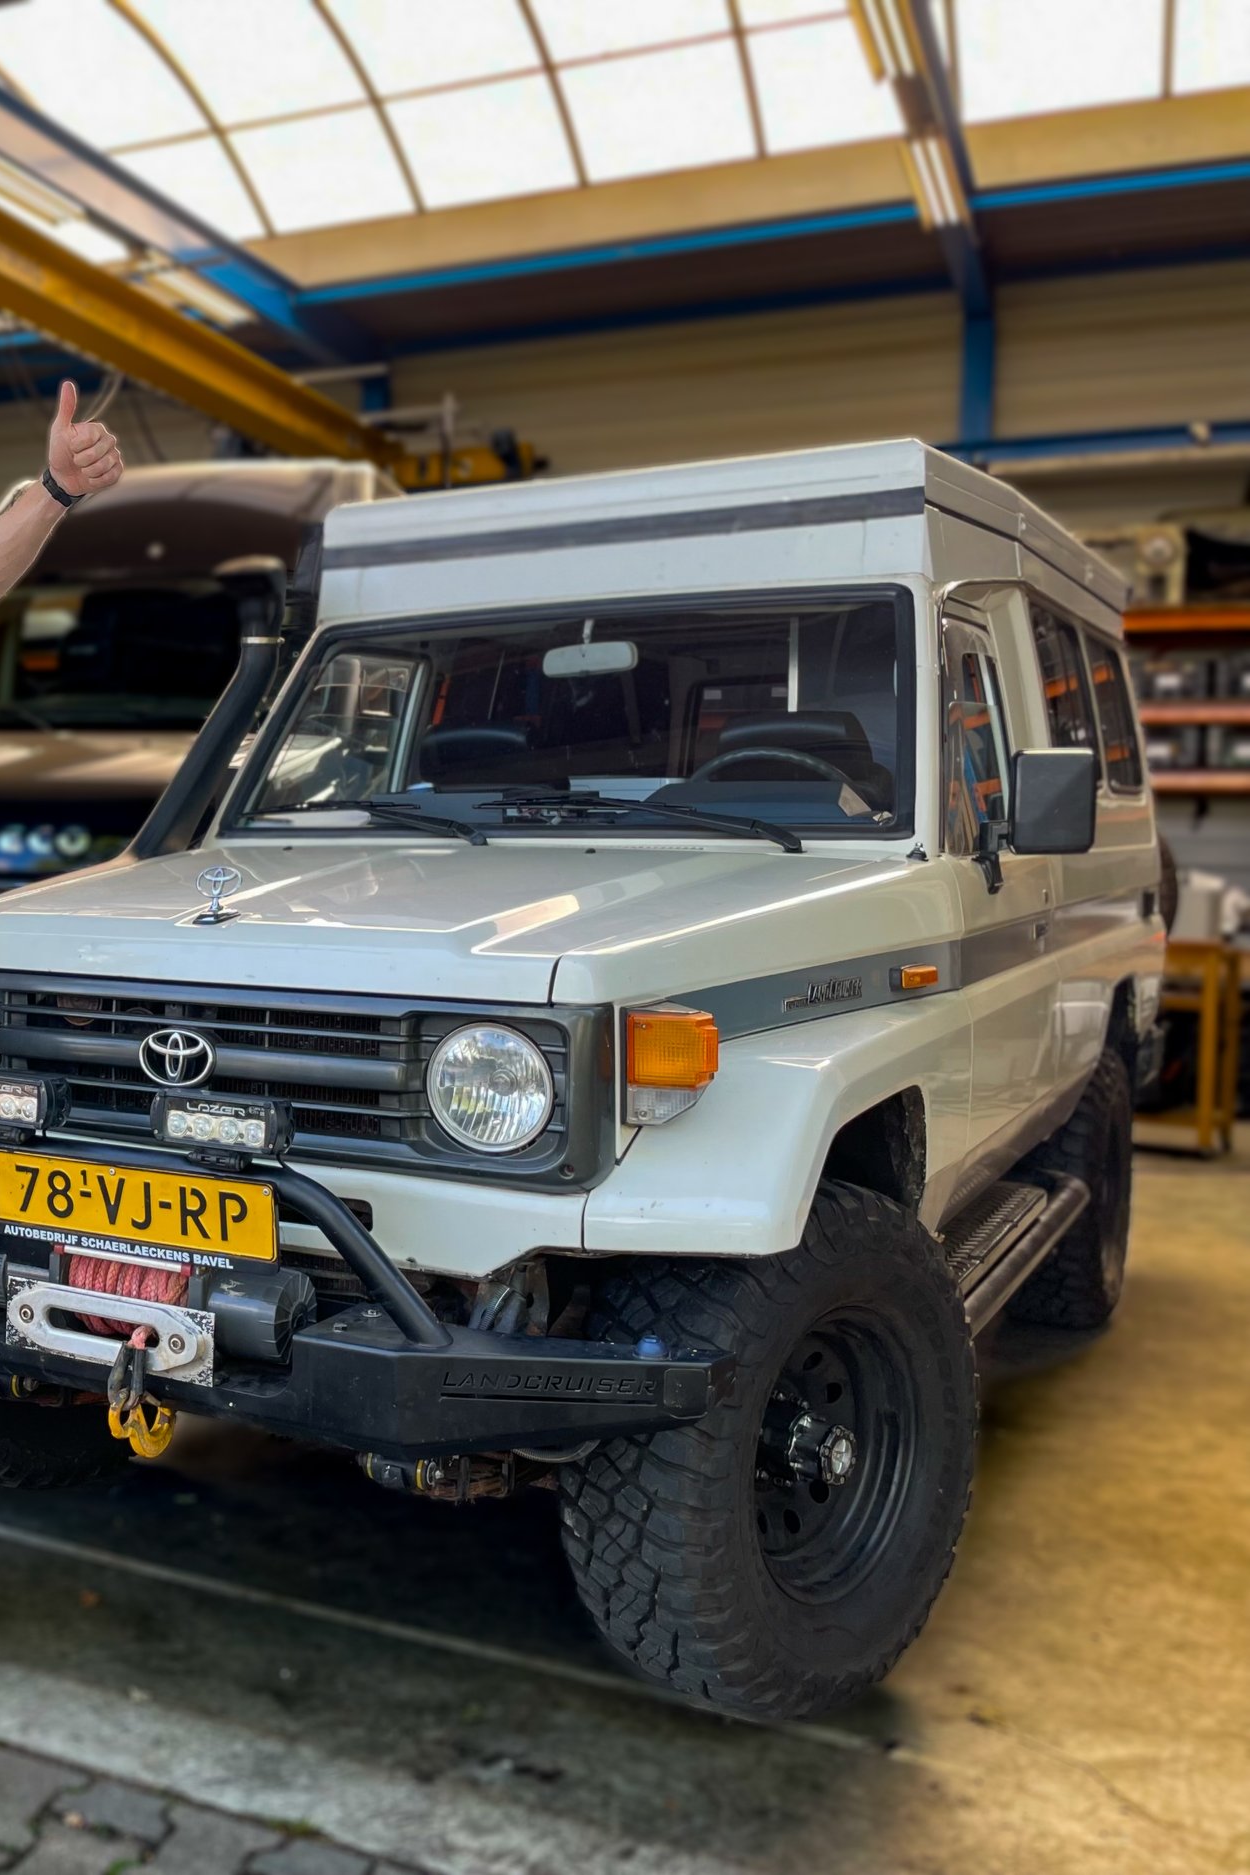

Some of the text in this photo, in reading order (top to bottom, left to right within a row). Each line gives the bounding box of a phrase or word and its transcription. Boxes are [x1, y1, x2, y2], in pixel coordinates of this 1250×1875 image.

[186, 1101, 246, 1117] LAZER
[3, 1224, 234, 1270] AUTOBEDRIJF SCHAERLAECKENS BAVEL
[442, 1371, 658, 1396] LANDCRUISER
